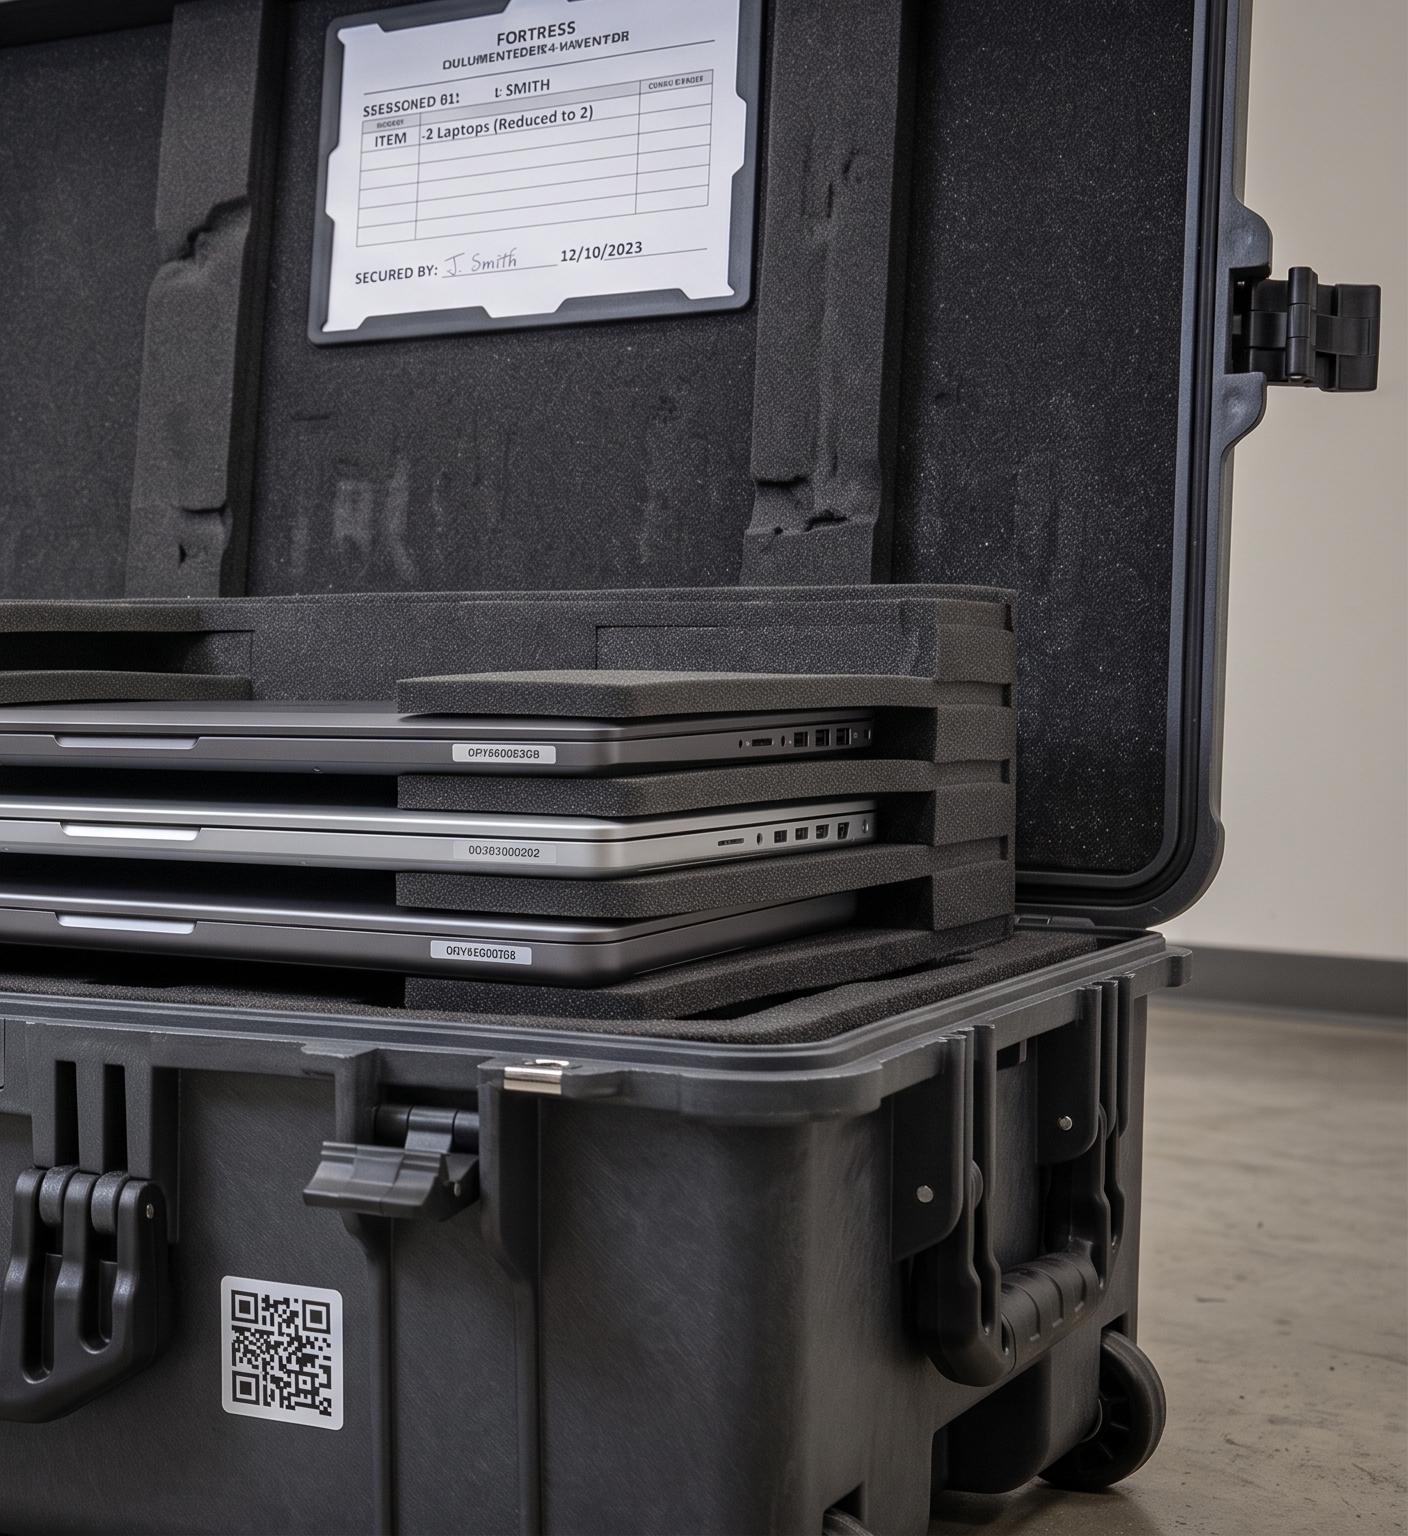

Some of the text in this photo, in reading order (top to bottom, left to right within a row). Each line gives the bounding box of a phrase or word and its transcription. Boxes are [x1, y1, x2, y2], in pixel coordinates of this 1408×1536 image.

[497, 21, 576, 46] FORTRESS
[506, 79, 551, 97] SMITH
[437, 121, 490, 140] Laptops
[493, 111, 557, 134] (Reduced
[562, 108, 577, 122] to
[580, 105, 594, 121] 2)
[374, 132, 407, 148] ITEM
[471, 247, 518, 272] Smith
[560, 241, 643, 263] 12/10/2023
[355, 265, 439, 285] SECURED BY:
